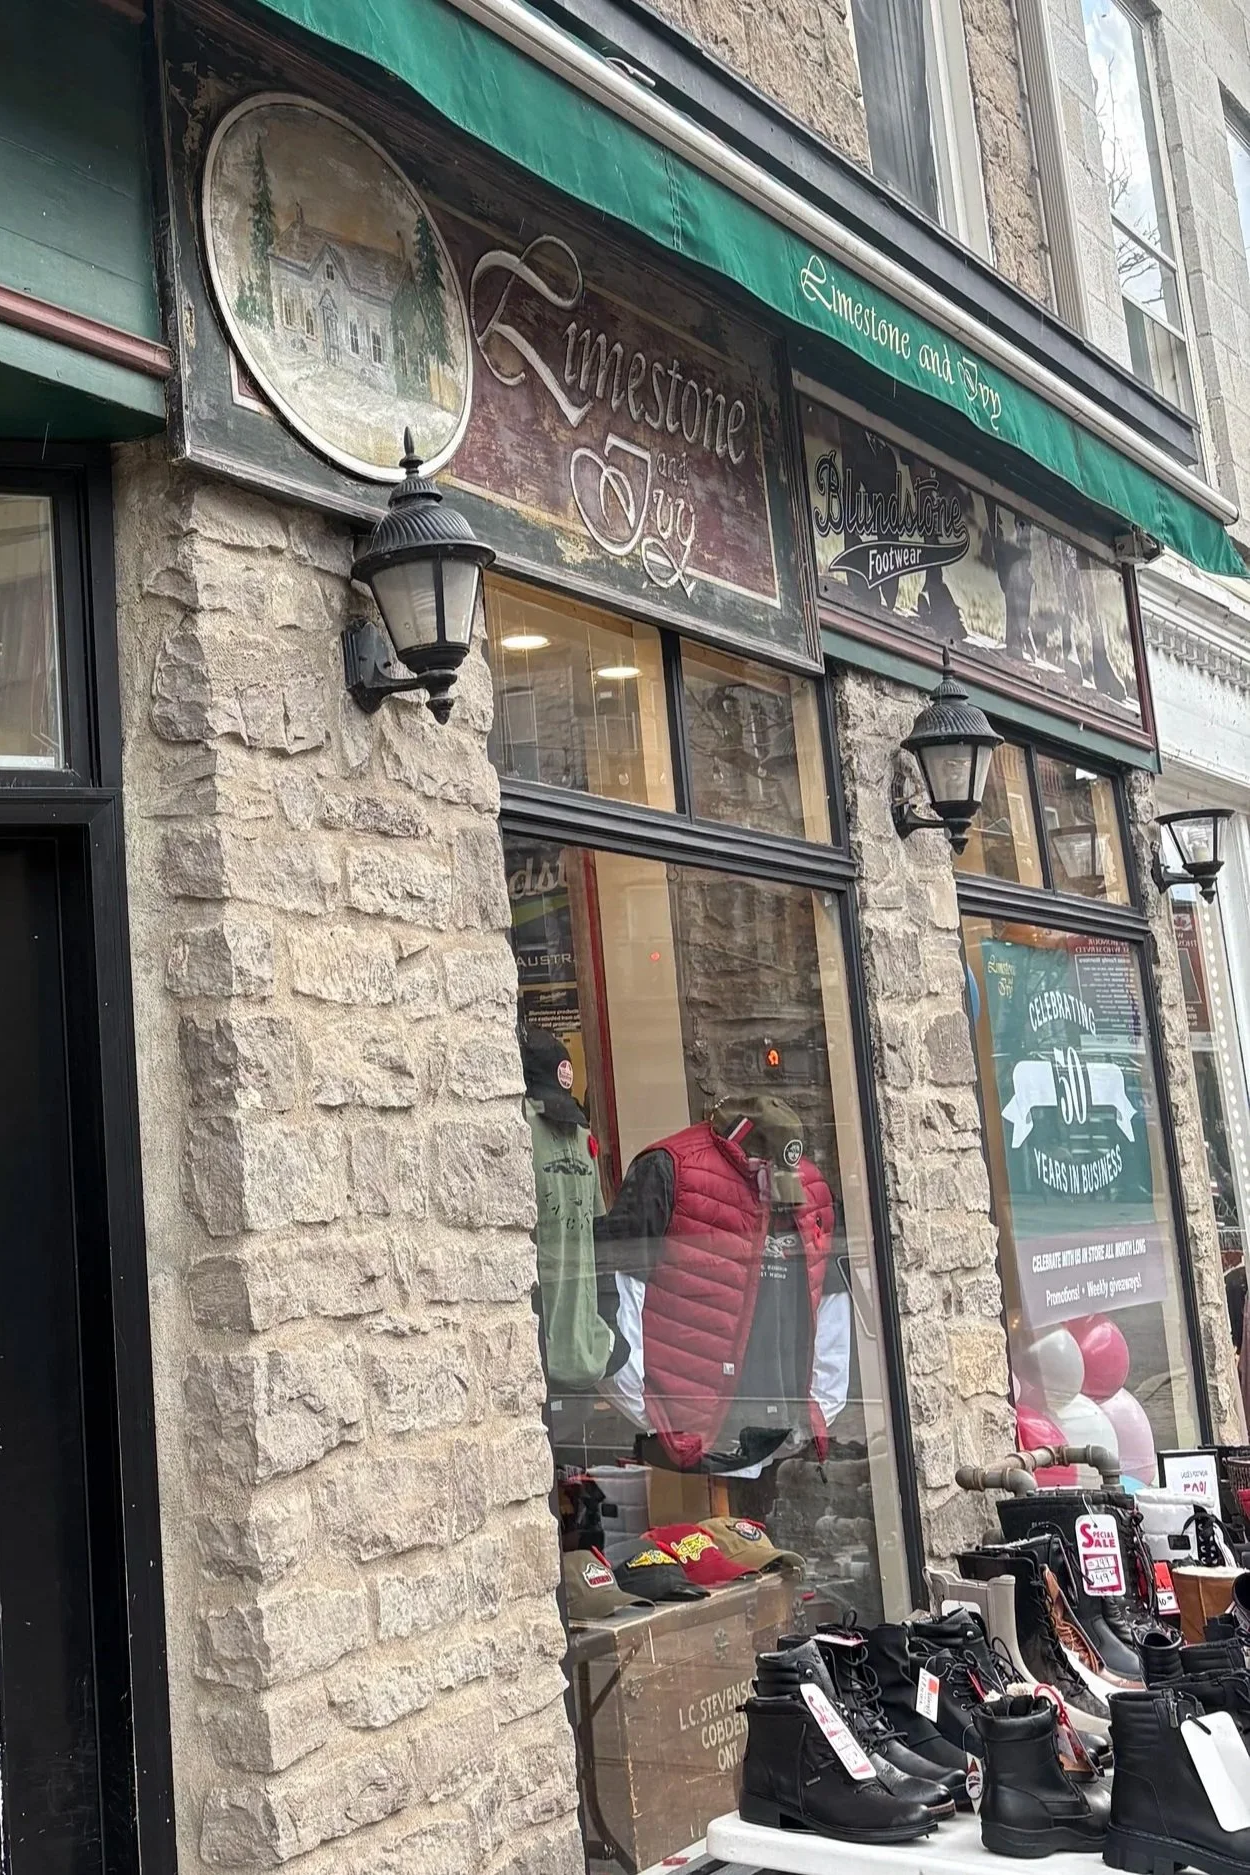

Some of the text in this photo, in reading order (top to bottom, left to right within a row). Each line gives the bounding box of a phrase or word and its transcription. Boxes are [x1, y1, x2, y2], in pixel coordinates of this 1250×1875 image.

[470, 233, 746, 465] Limestone
[800, 255, 1002, 431] Limestone and Ivy
[570, 432, 698, 599] Ivy
[813, 450, 968, 538] Blundstone
[868, 546, 922, 580] Footwear
[516, 952, 576, 967] AUSTR
[1029, 991, 1096, 1037] CELEBRATING
[1053, 1046, 1087, 1125] 50
[1034, 1143, 1123, 1195] YEARS IN BUSINESS
[1032, 1251, 1061, 1273] CELEBRATE
[1061, 1249, 1075, 1268] WITH
[1088, 1244, 1105, 1263] STORE
[1105, 1243, 1114, 1260] ALL
[1115, 1239, 1132, 1258] MONTH
[1132, 1238, 1146, 1256] LONG
[1046, 1272, 1143, 1307] Promotions! Weekly giveaways!
[679, 1704, 700, 1732] L.C.
[701, 1713, 749, 1750] COBDEN
